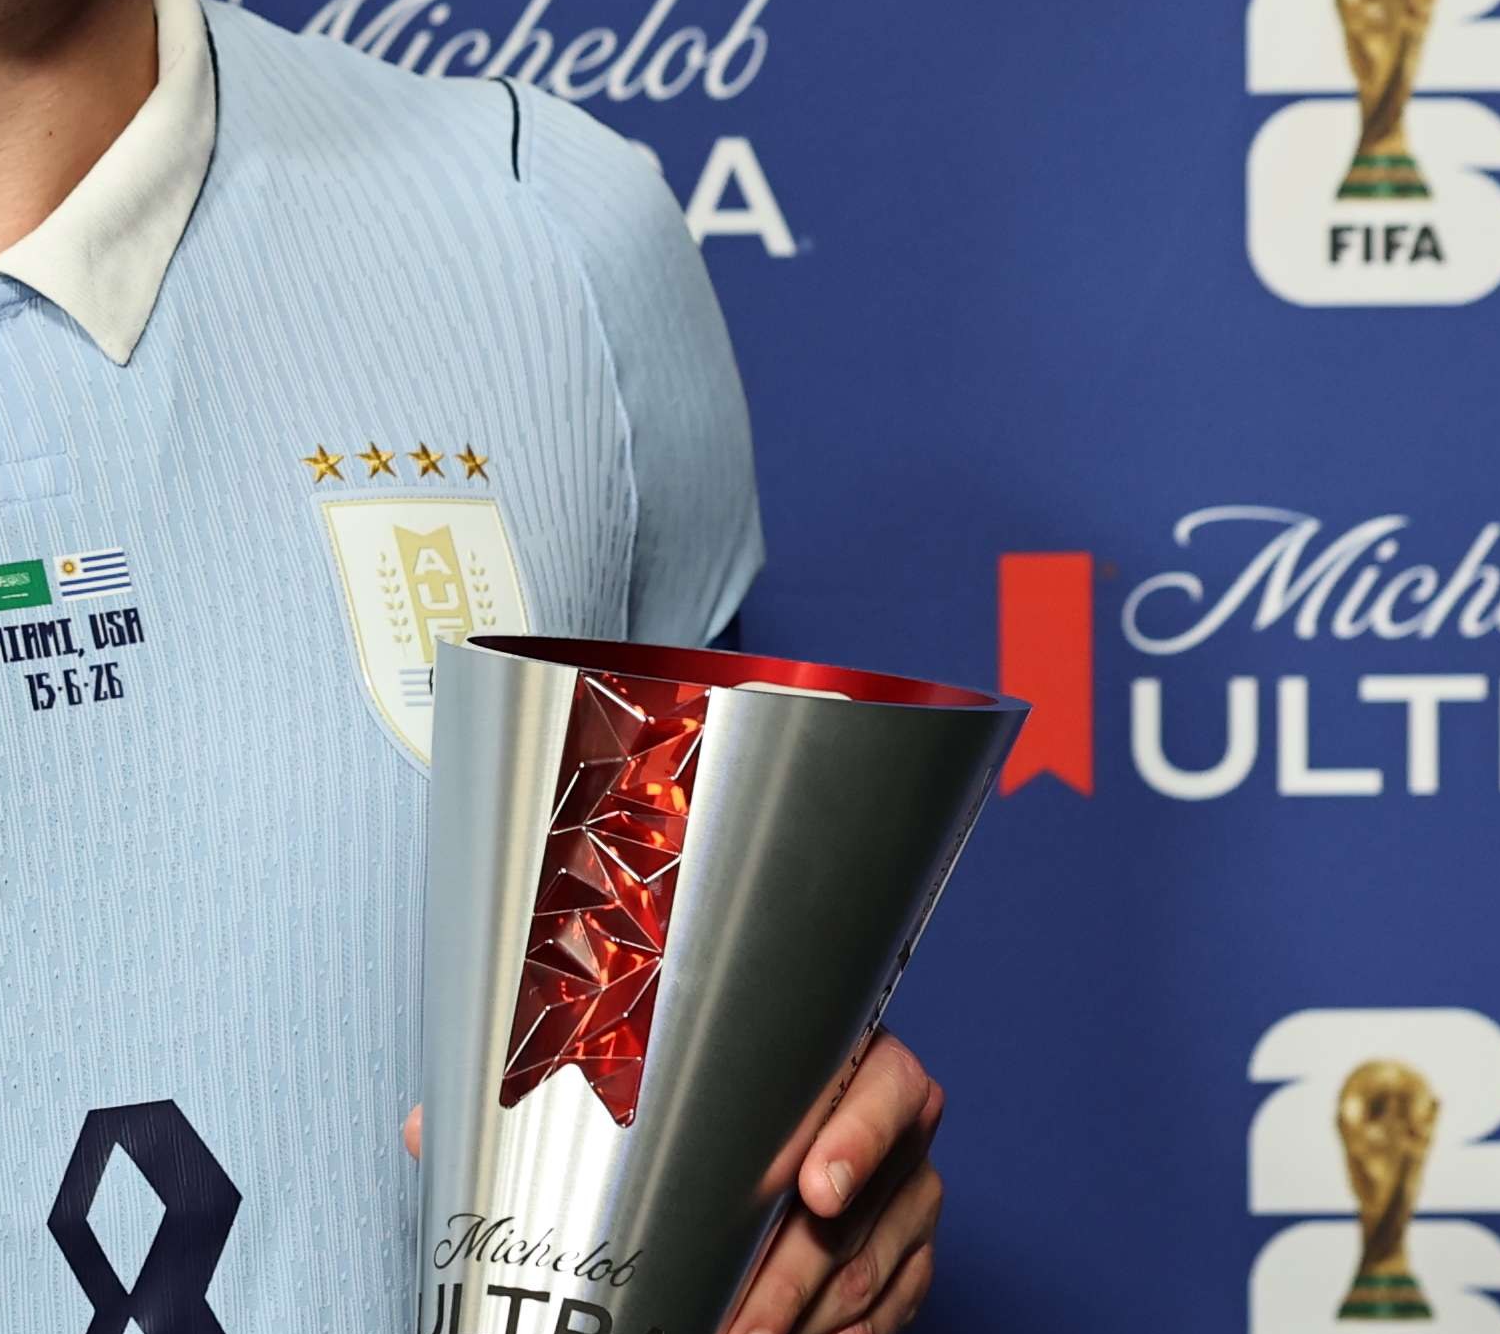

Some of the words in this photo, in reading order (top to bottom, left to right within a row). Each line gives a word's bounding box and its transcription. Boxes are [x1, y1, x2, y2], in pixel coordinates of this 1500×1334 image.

[1330, 225, 1443, 263] FIFA
[88, 607, 145, 649] USA
[433, 1212, 644, 1288] Michelob
